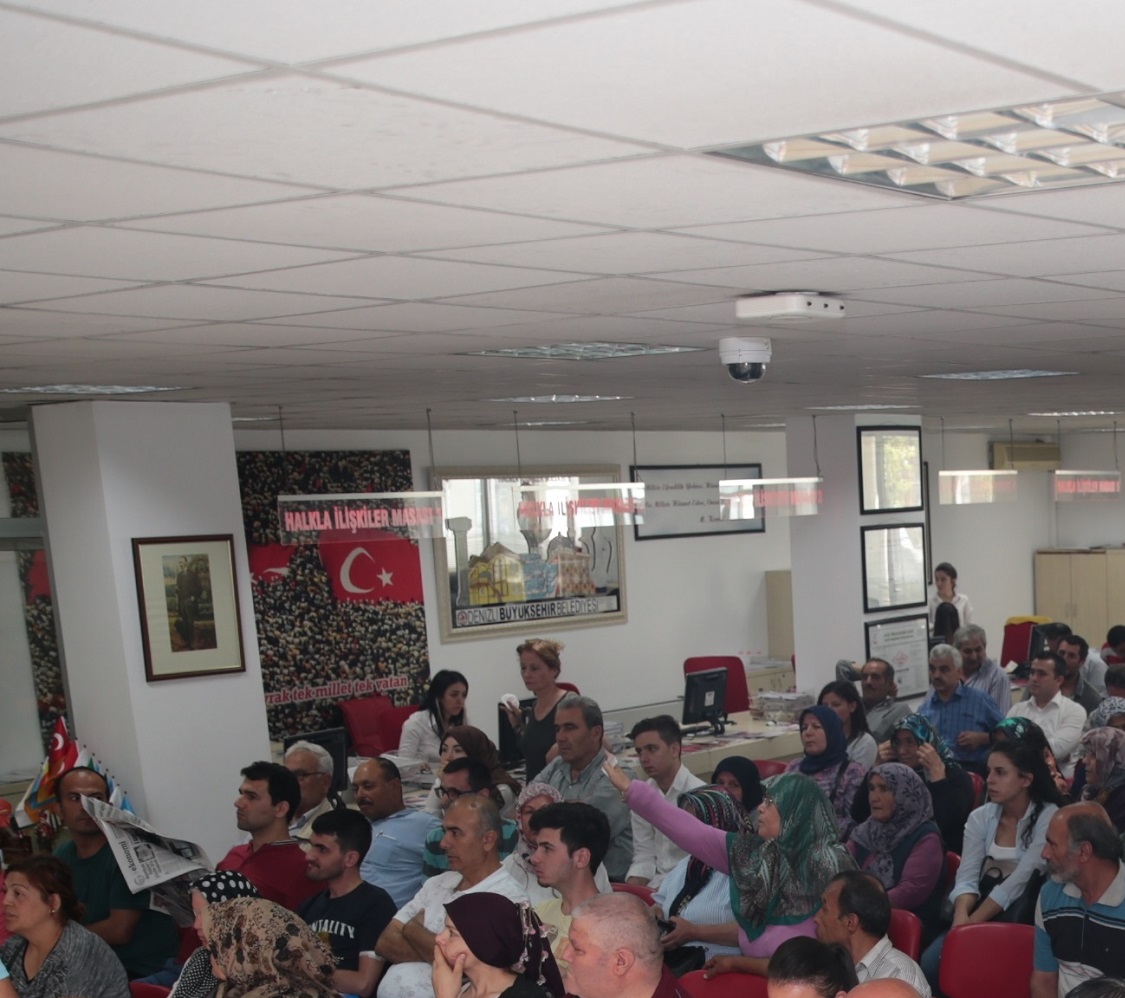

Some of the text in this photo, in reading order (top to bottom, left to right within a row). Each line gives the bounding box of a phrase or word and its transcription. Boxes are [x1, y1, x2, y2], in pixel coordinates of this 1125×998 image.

[285, 508, 333, 532] HALKLA
[333, 505, 390, 534] İLİŞKİLER
[292, 687, 313, 701] tek
[315, 682, 353, 698] millet
[354, 678, 374, 693] tek
[374, 674, 409, 690] vatan
[118, 840, 137, 872] ekonomi
